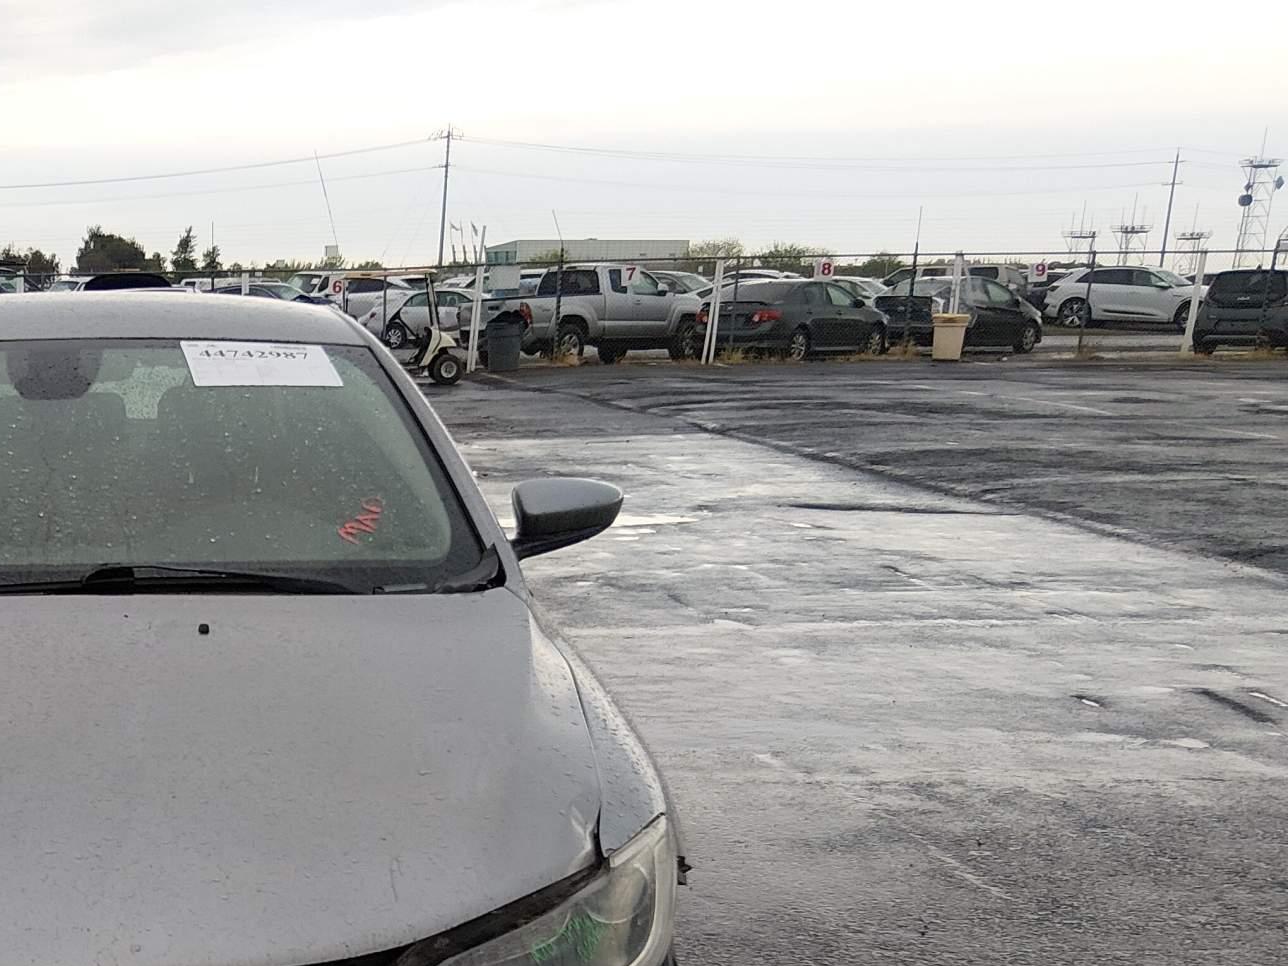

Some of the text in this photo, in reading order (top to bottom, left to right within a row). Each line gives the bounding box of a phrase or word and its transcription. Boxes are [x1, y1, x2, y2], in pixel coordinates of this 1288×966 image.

[626, 267, 636, 279] 7
[821, 262, 831, 276] 8
[1035, 264, 1046, 277] 9
[332, 280, 342, 294] 6
[199, 349, 308, 360] 44742987
